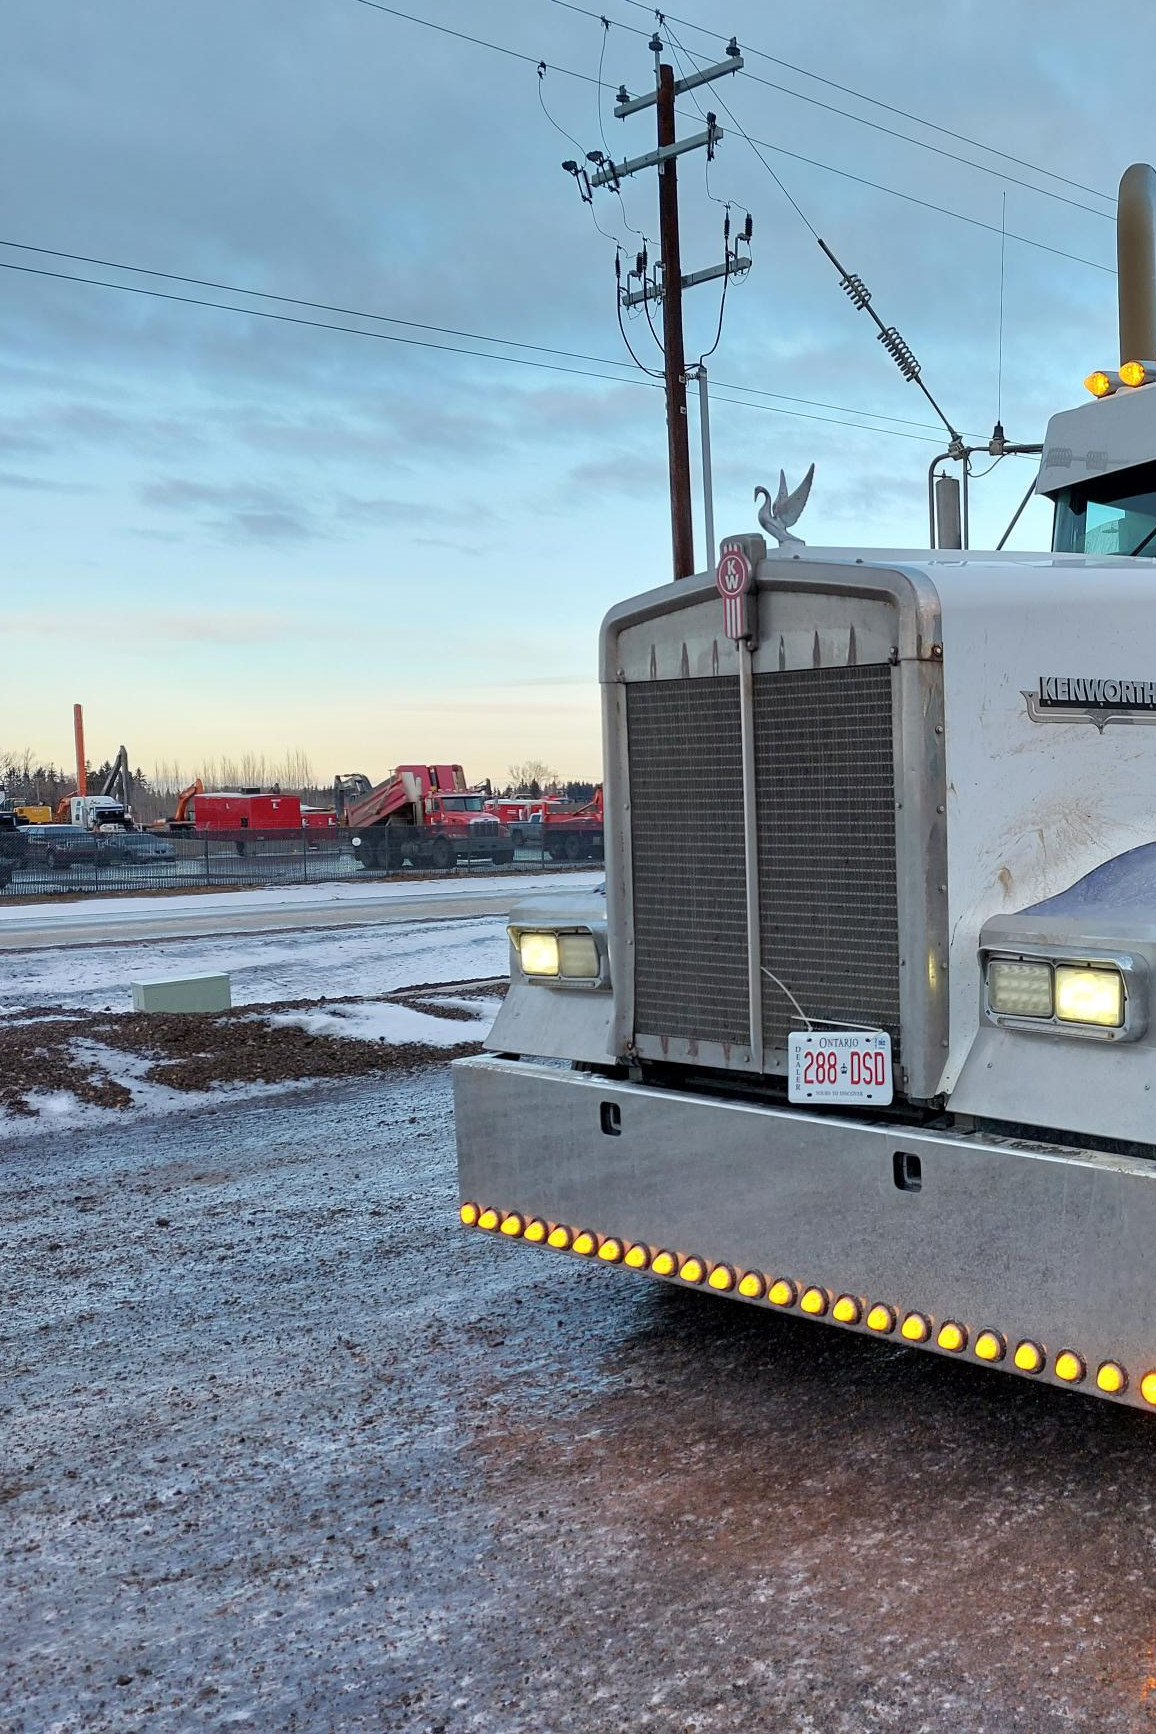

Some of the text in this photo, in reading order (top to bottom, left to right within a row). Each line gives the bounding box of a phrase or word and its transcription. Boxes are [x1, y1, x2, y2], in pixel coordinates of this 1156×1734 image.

[1039, 677, 1156, 704] KENWORTH
[819, 1037, 859, 1048] ONTARIO
[804, 1051, 885, 1085] 288 DSD
